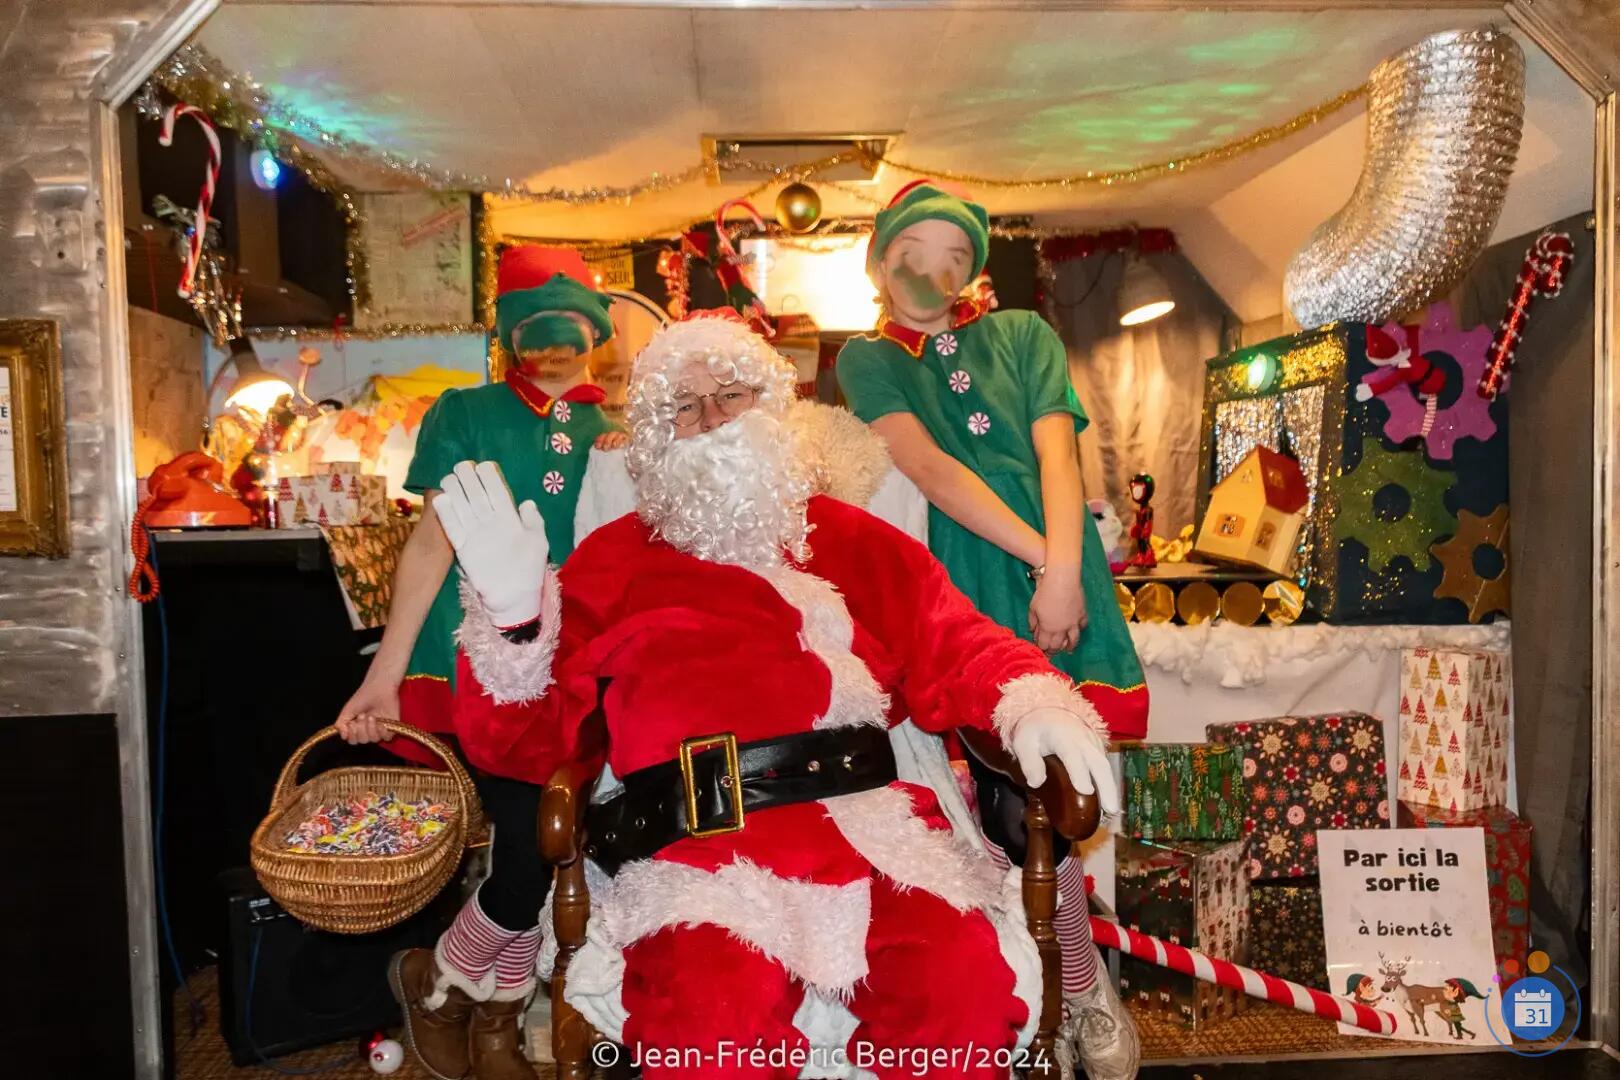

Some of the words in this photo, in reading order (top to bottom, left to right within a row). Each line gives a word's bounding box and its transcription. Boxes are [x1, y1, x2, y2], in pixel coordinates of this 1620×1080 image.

[1343, 849, 1388, 867] Par
[1398, 847, 1427, 867] ici
[1435, 848, 1459, 867] la
[1365, 872, 1440, 892] sortie
[1358, 919, 1370, 936] à
[1377, 920, 1453, 938] bientôt
